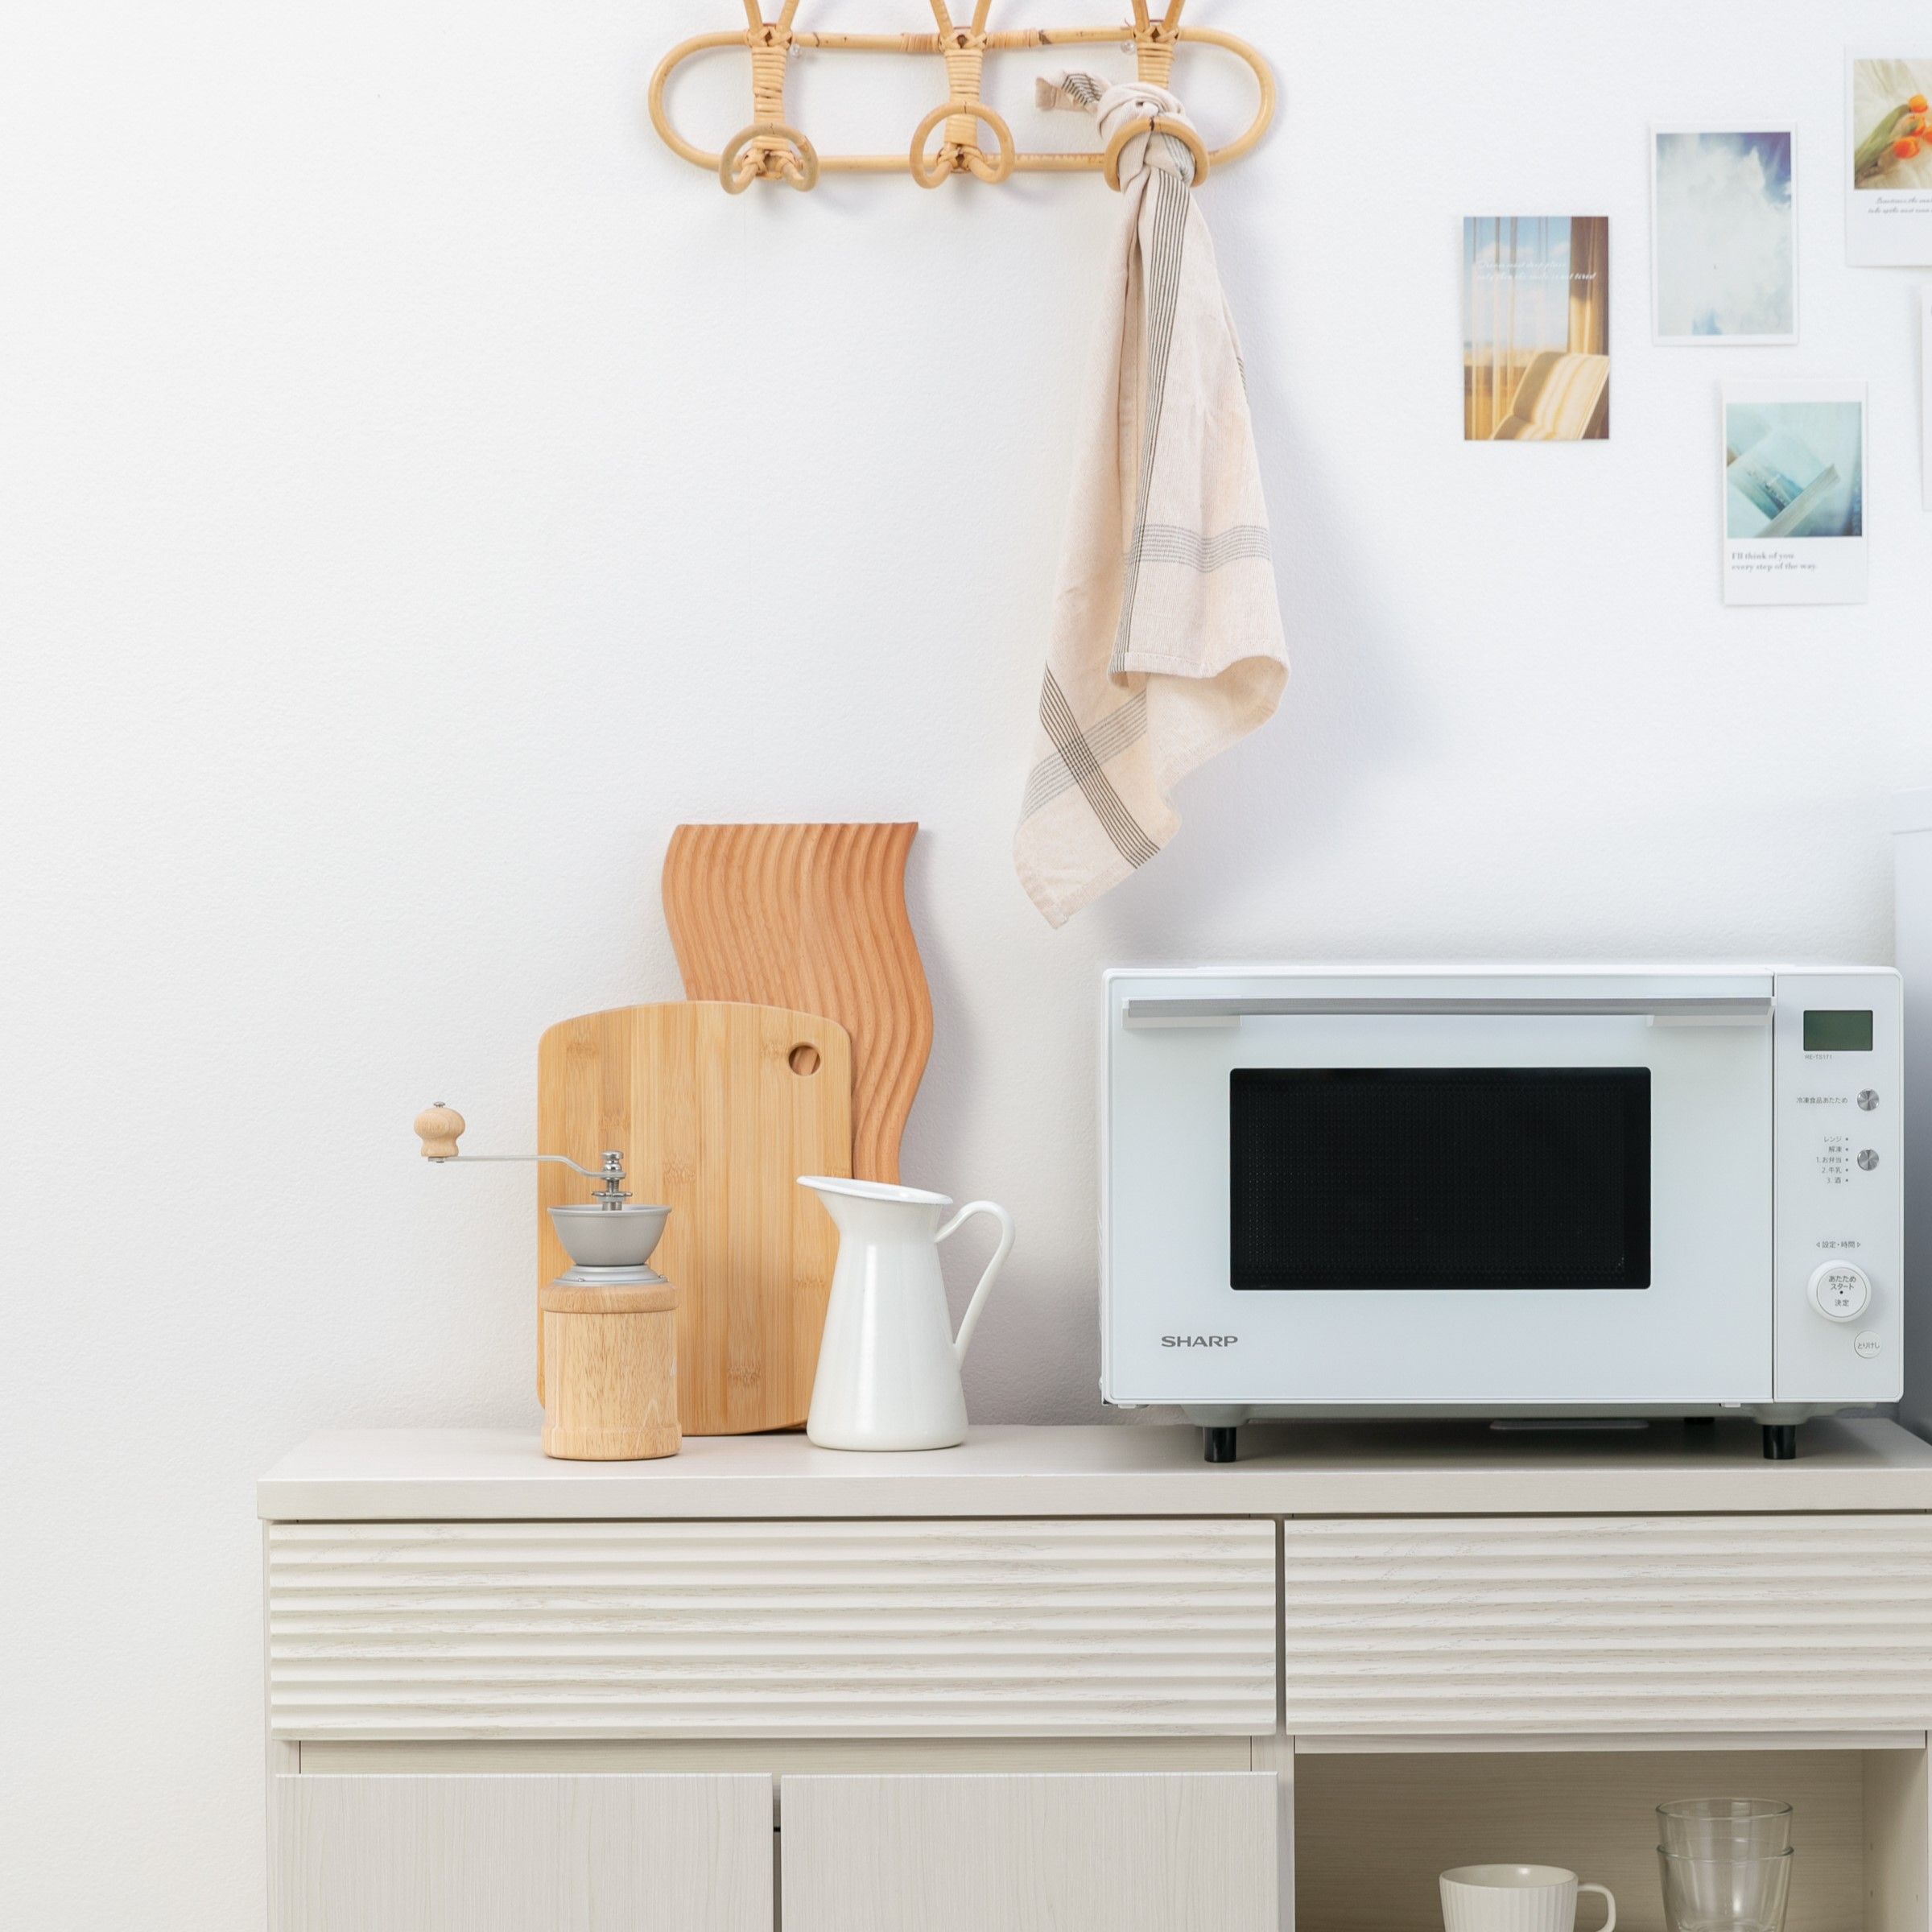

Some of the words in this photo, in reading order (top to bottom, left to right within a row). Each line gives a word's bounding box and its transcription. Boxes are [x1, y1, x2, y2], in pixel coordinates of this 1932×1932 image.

[1796, 1096, 1848, 1104] 冷凍食品あたため
[1831, 1282, 1854, 1290] スタート
[1835, 1298, 1849, 1307] 決定
[1161, 1335, 1238, 1348] SHARP
